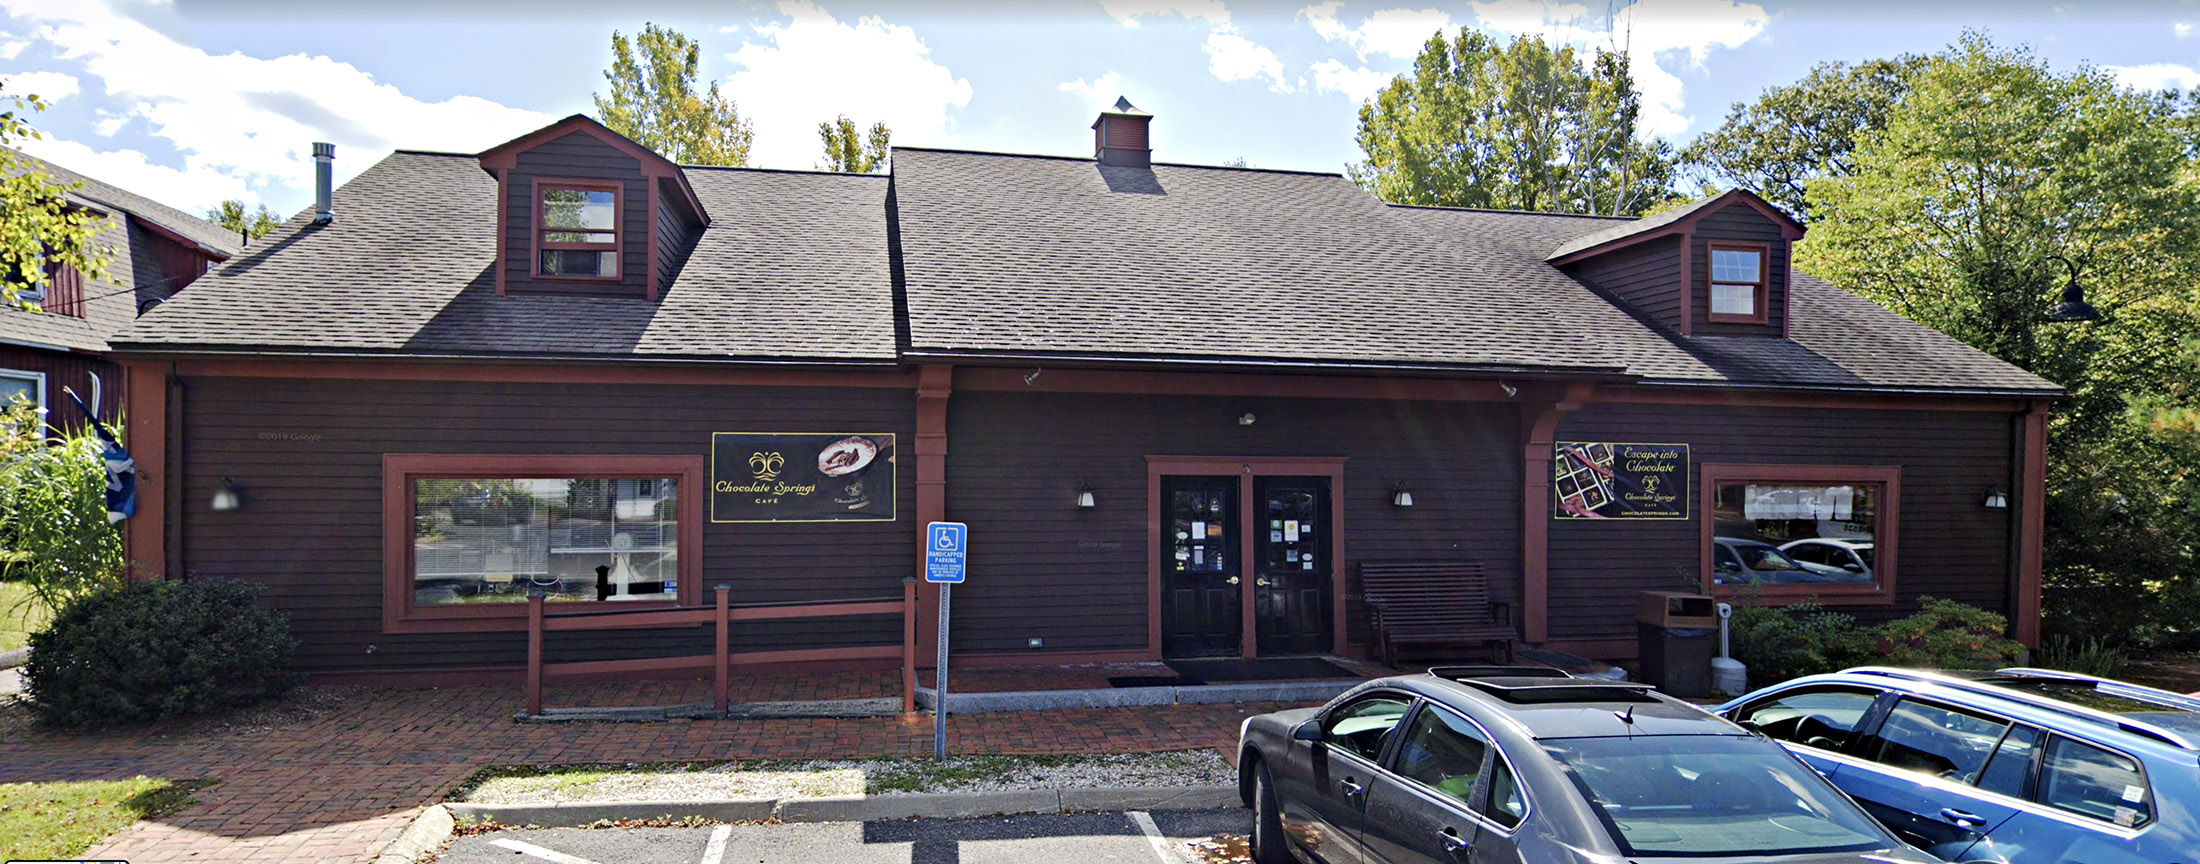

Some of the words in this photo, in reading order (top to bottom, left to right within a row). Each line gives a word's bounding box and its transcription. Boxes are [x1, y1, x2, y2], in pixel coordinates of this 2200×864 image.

[1624, 447, 1658, 461] Escape
[1660, 450, 1678, 459] into
[1626, 460, 1674, 472] Chocolate
[715, 480, 770, 493] Chocolate
[772, 481, 816, 496] Springs
[1625, 492, 1653, 500] Chocolate
[1654, 493, 1676, 502] Springs
